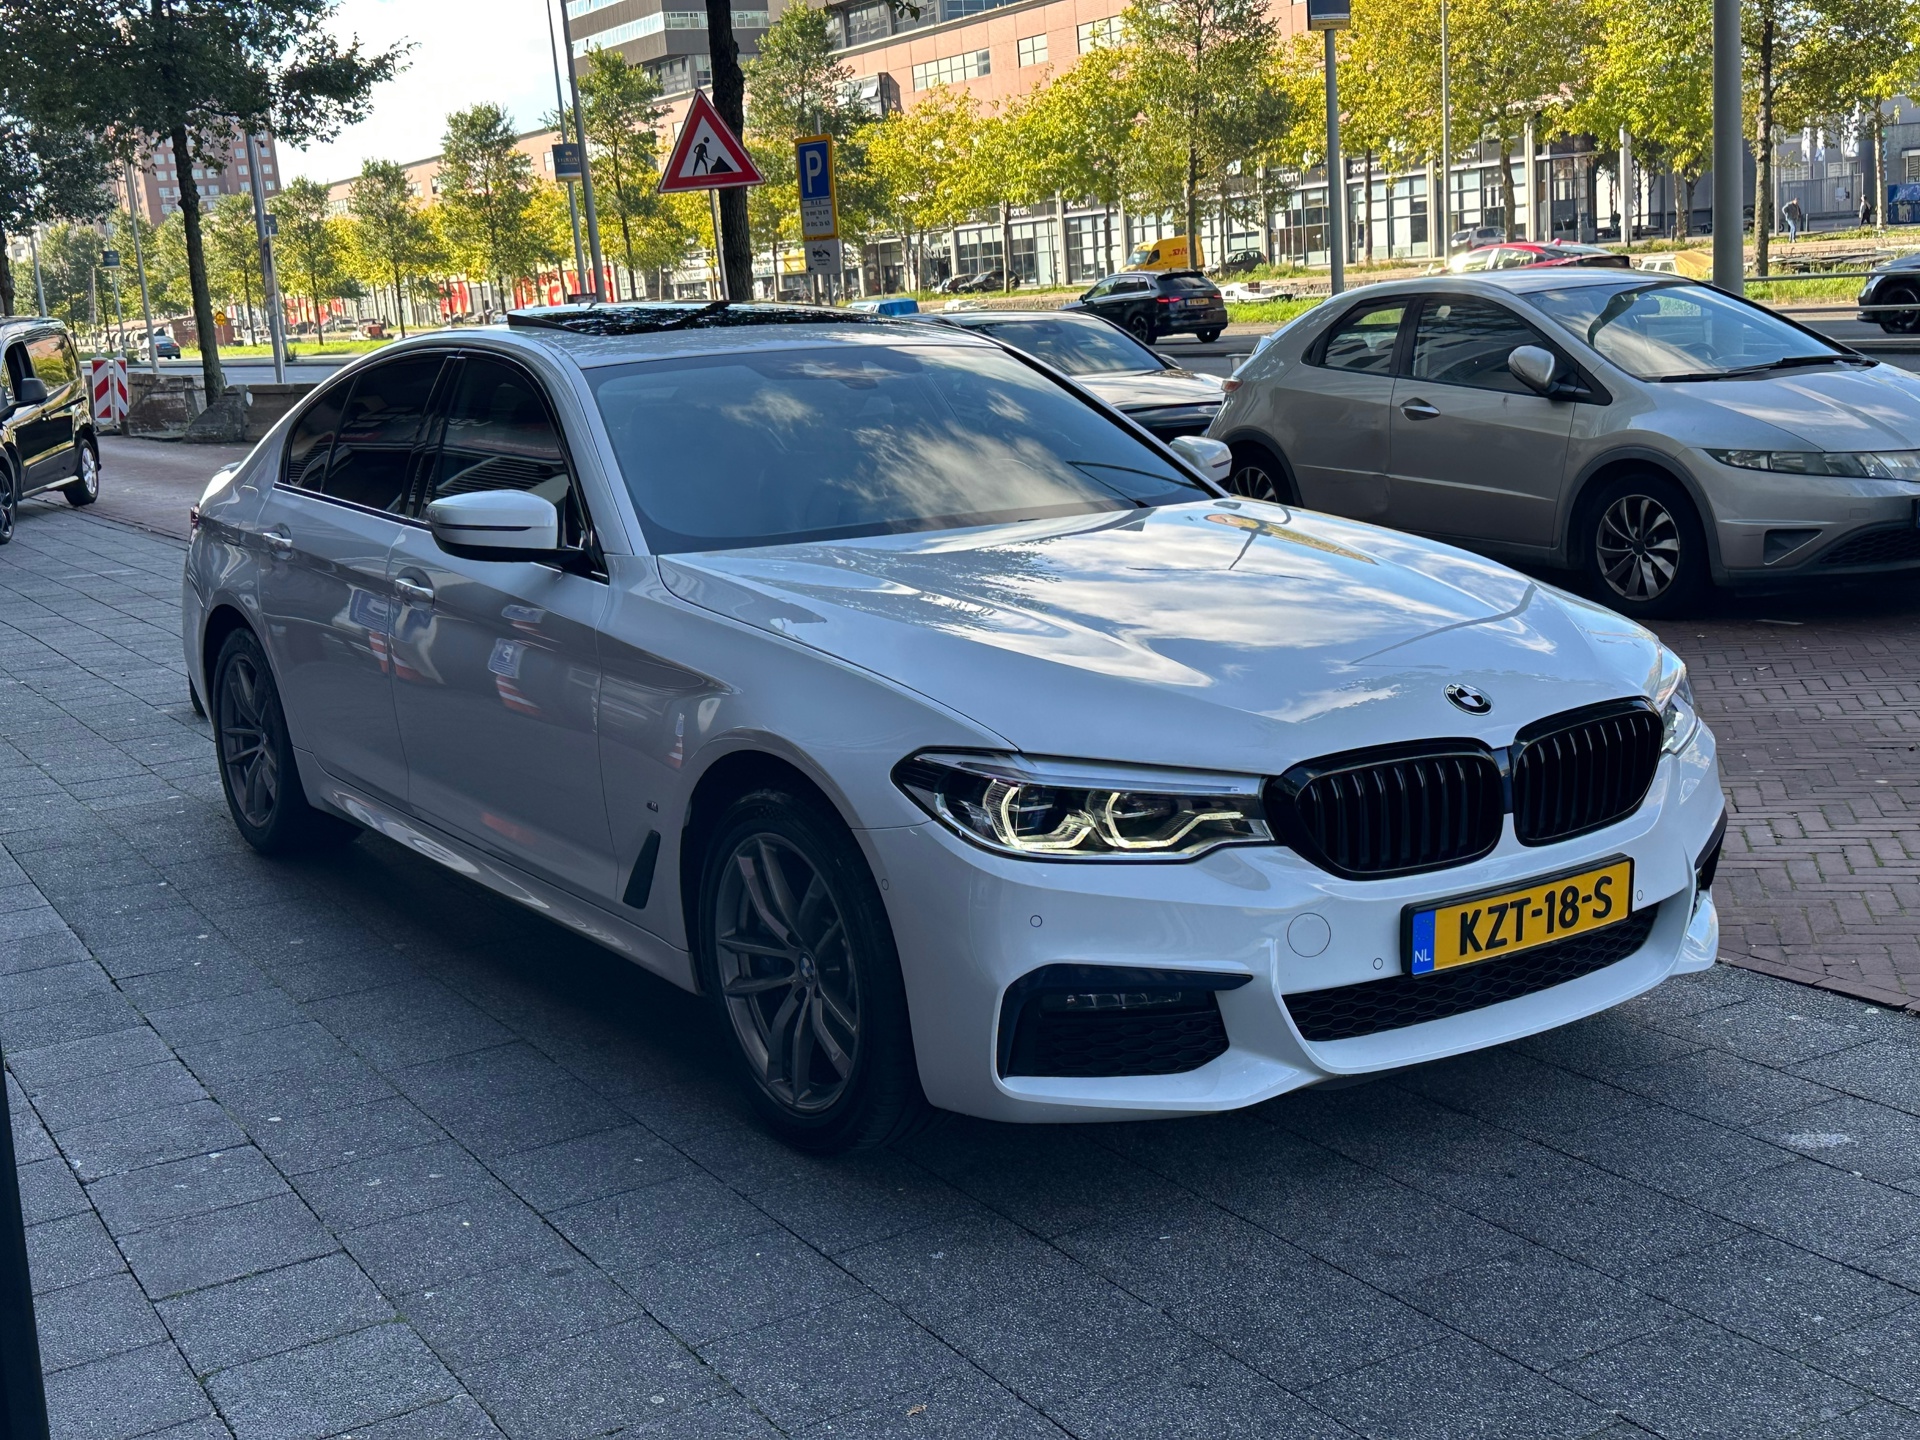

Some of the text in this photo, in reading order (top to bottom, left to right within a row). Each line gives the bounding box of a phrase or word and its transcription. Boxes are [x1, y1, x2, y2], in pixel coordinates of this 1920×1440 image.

[805, 150, 823, 194] P
[1459, 875, 1613, 956] KZT-18-S
[1414, 950, 1431, 963] NL
